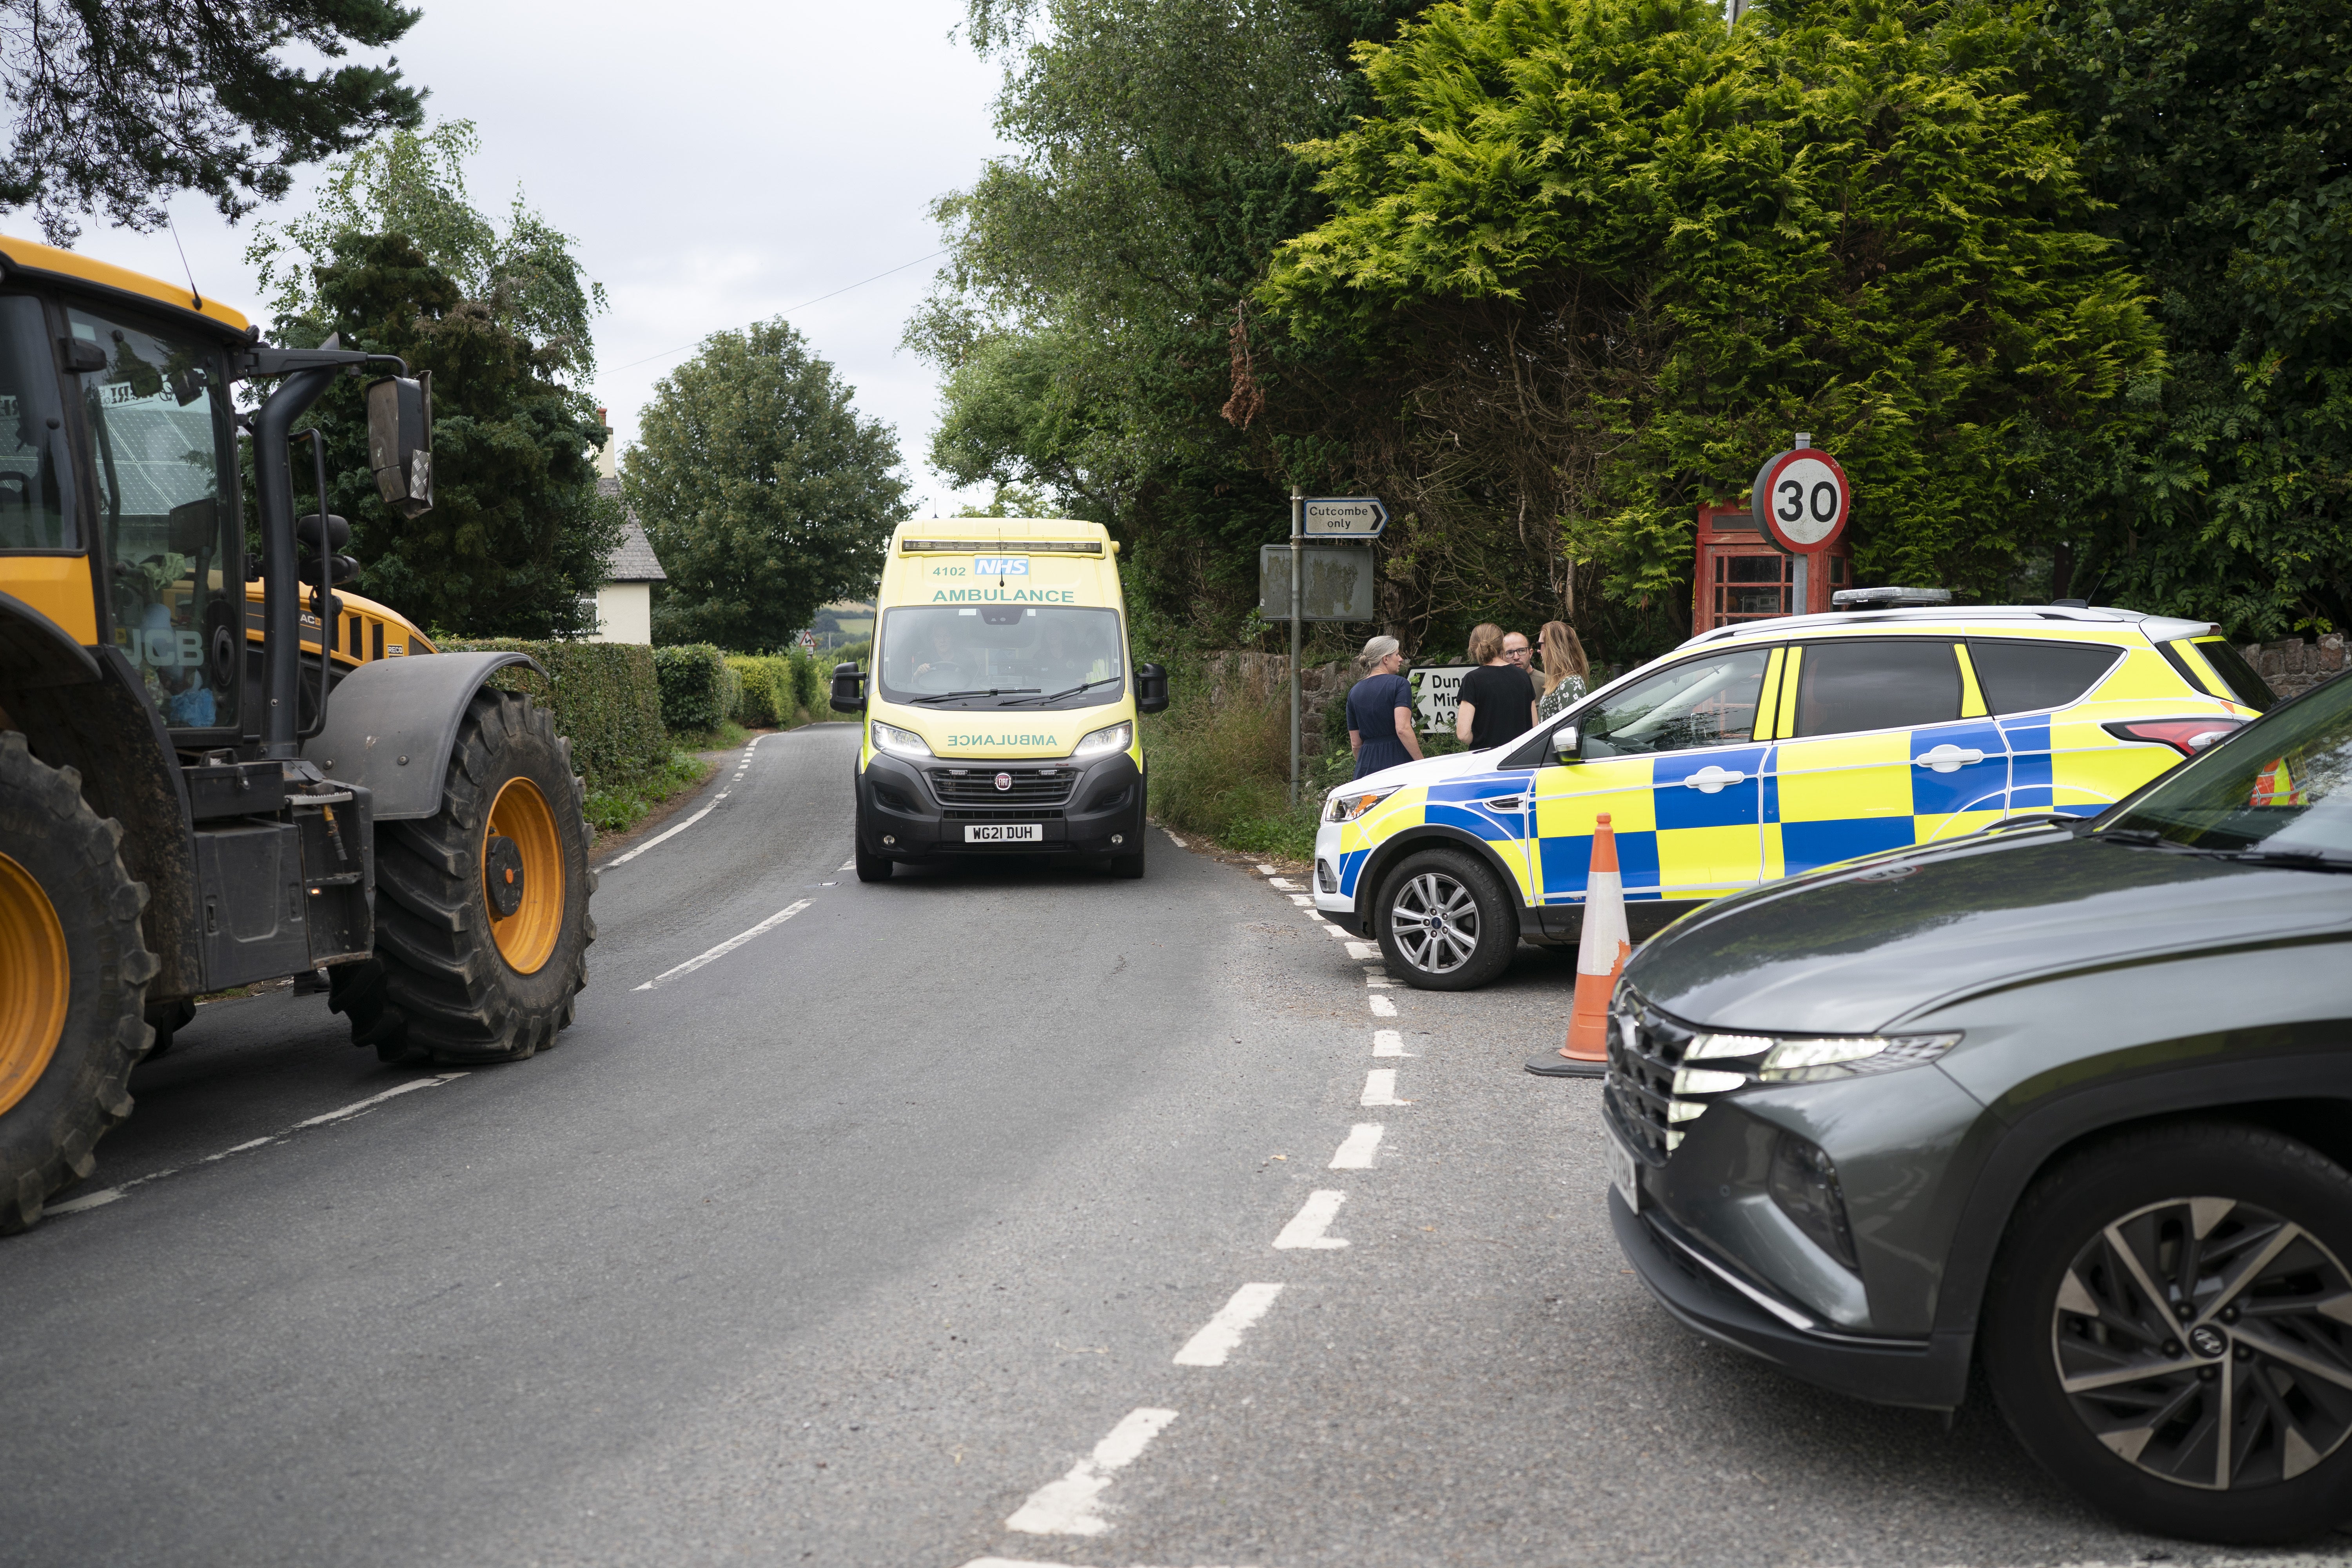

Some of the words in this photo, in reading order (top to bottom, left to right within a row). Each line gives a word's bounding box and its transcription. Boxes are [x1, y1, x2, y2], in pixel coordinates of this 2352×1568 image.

[1777, 480, 1837, 523] 30
[1309, 506, 1368, 516] Cutcombe
[1327, 519, 1351, 529] only
[933, 567, 965, 576] 4102
[976, 559, 1027, 574] NHS
[932, 589, 1074, 603] AMBULANCE
[300, 614, 315, 624] AC
[120, 629, 204, 666] JCB
[1432, 675, 1460, 688] Dun
[1434, 693, 1460, 707] Min
[1435, 711, 1456, 725] A3
[973, 827, 1003, 839] WG21
[1007, 826, 1032, 838] DUH
